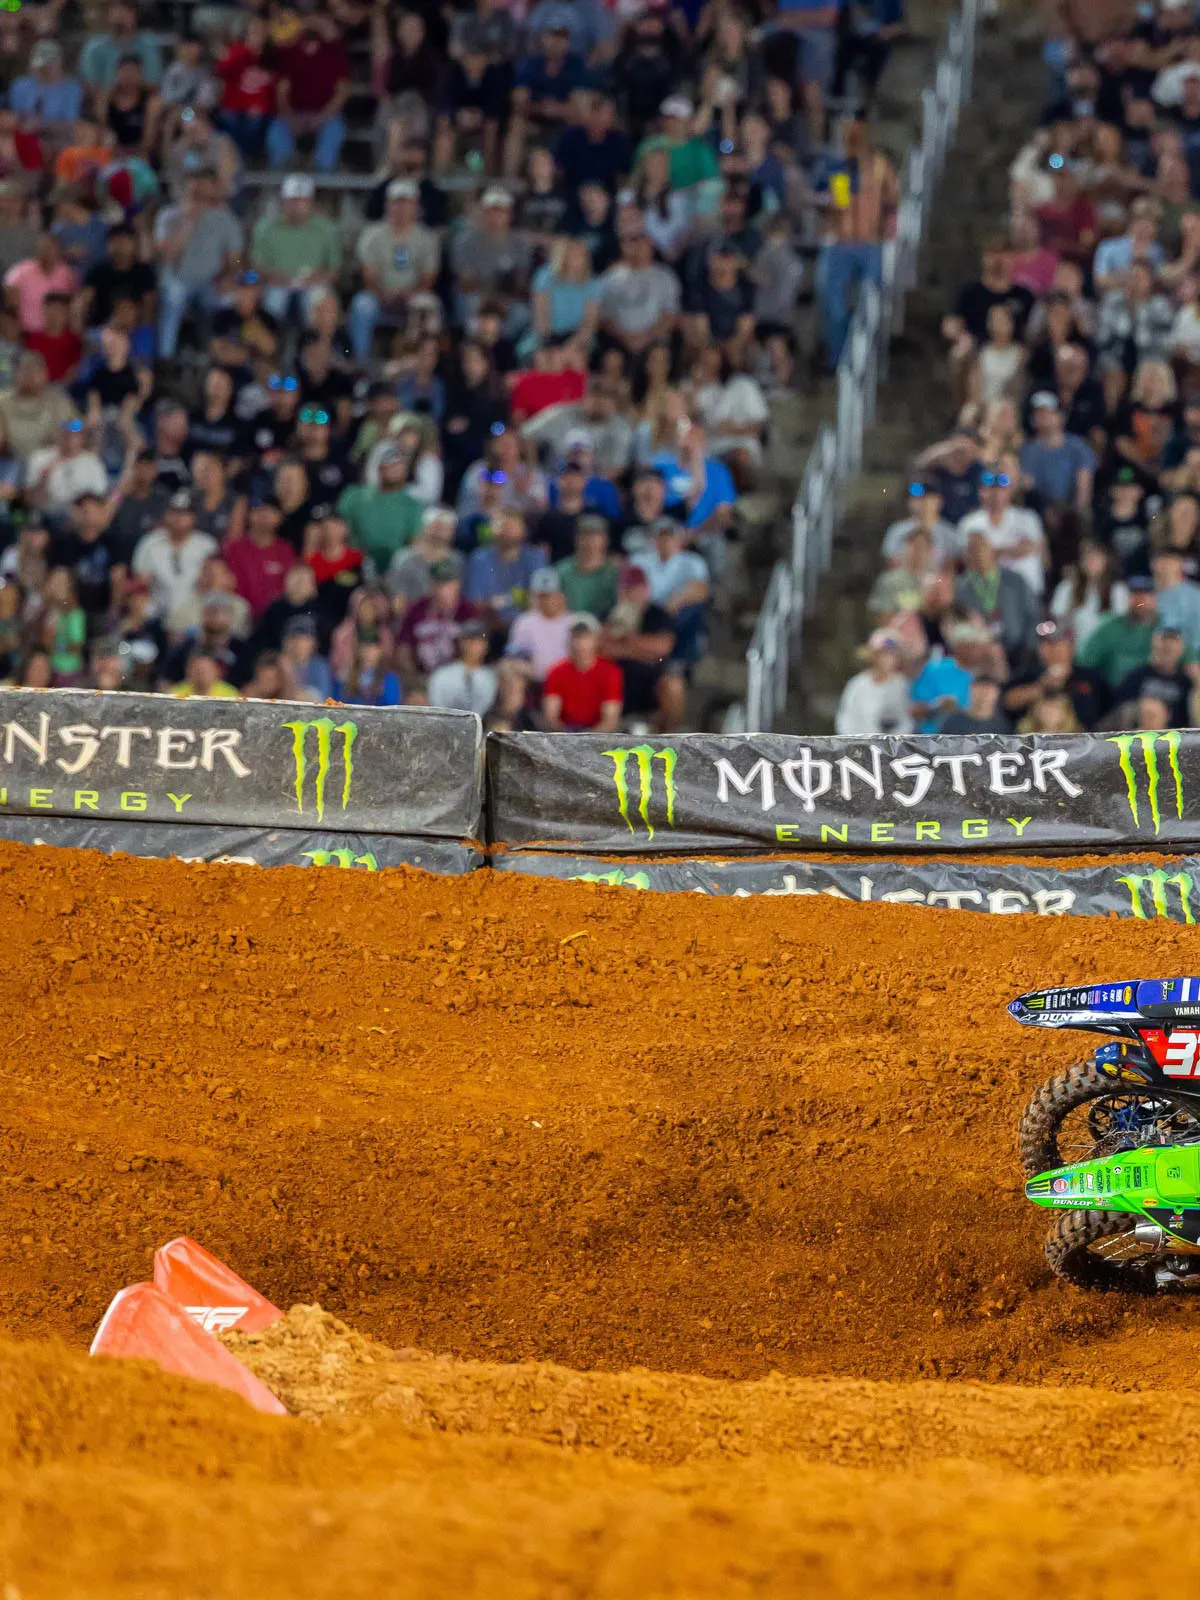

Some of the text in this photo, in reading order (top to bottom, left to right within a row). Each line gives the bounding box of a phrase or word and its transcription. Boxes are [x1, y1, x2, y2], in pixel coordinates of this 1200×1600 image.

[715, 745, 1085, 813] MONSTER
[775, 815, 1034, 842] ENERGY
[1052, 1198, 1093, 1207] DUNLOP
